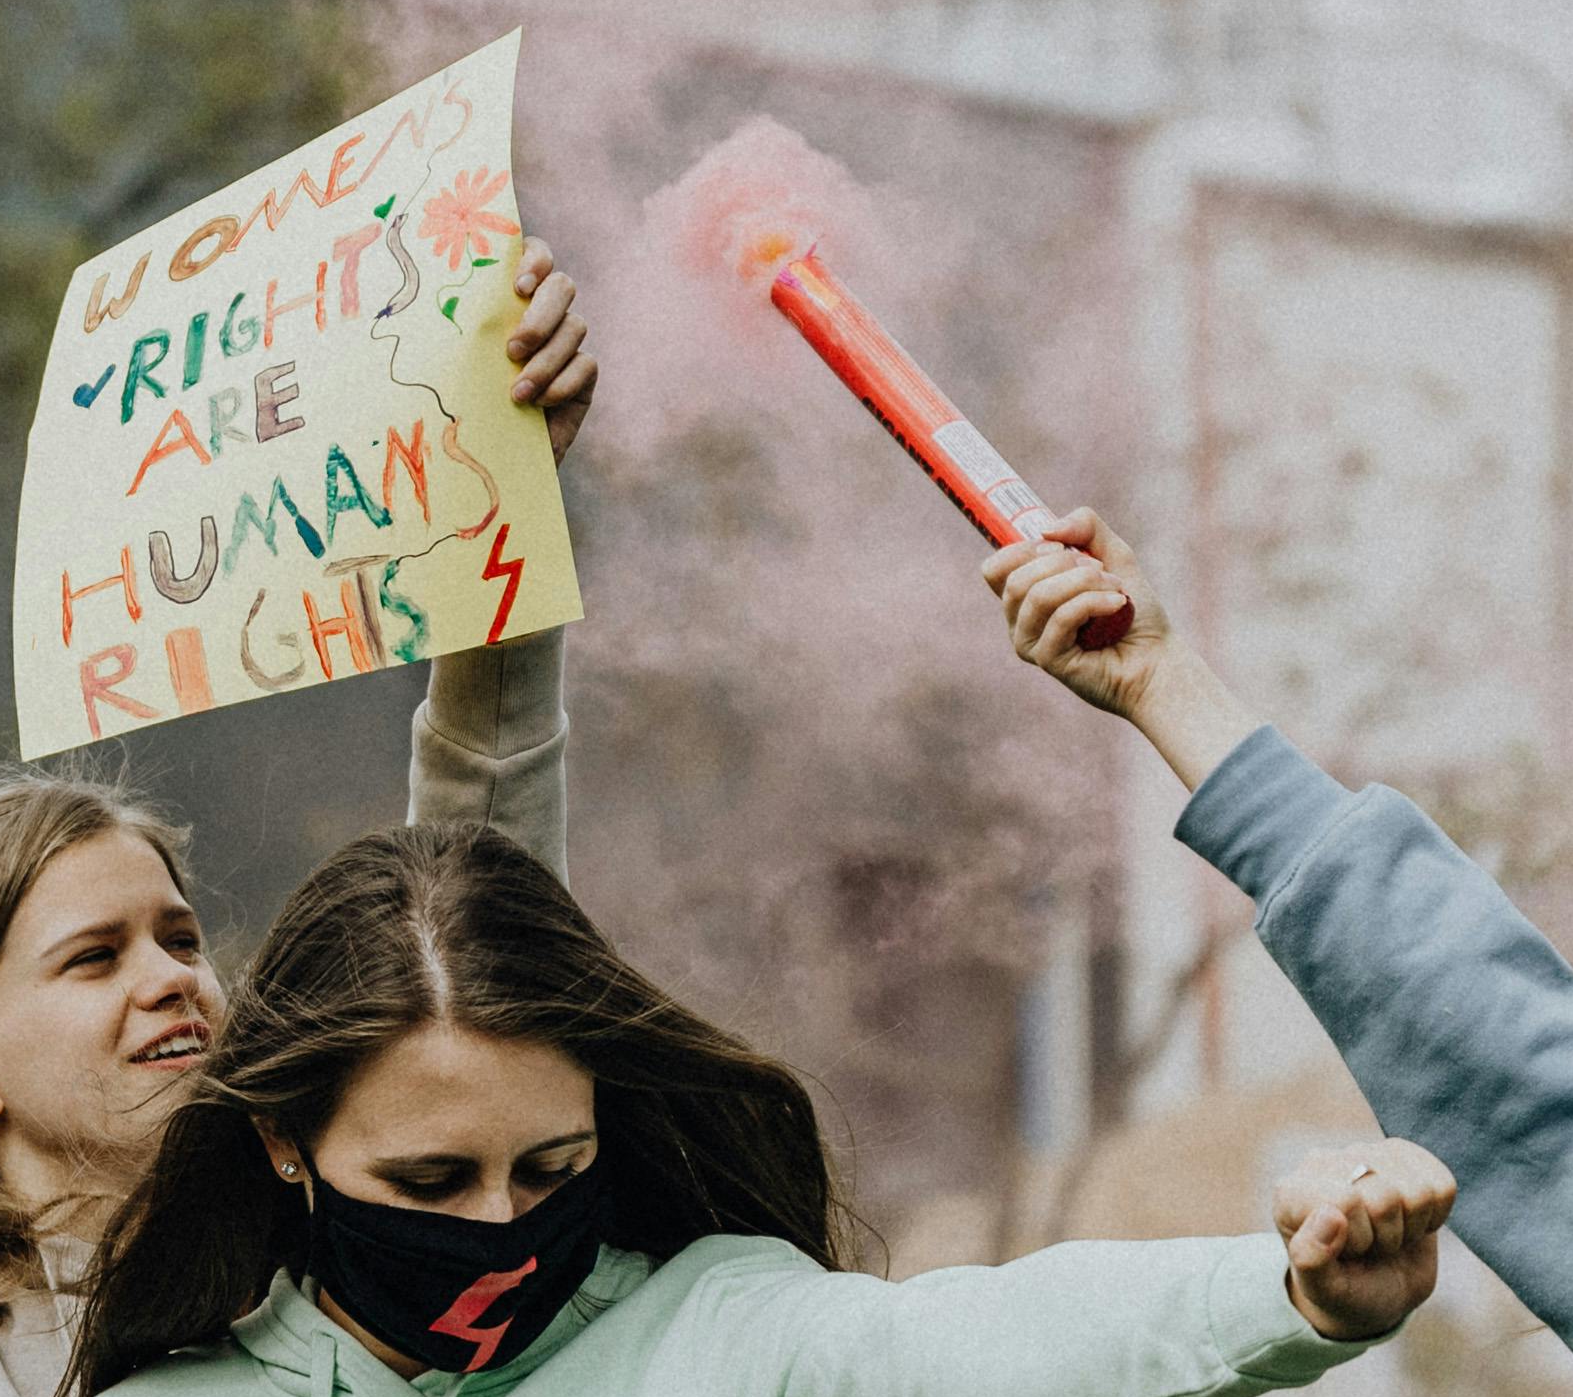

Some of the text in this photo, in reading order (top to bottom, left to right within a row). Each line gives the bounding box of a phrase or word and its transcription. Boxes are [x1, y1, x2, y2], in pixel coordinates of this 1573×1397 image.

[120, 213, 420, 423] RIGHTS
[126, 360, 304, 497] ARE
[78, 553, 431, 740] RIGHTS
